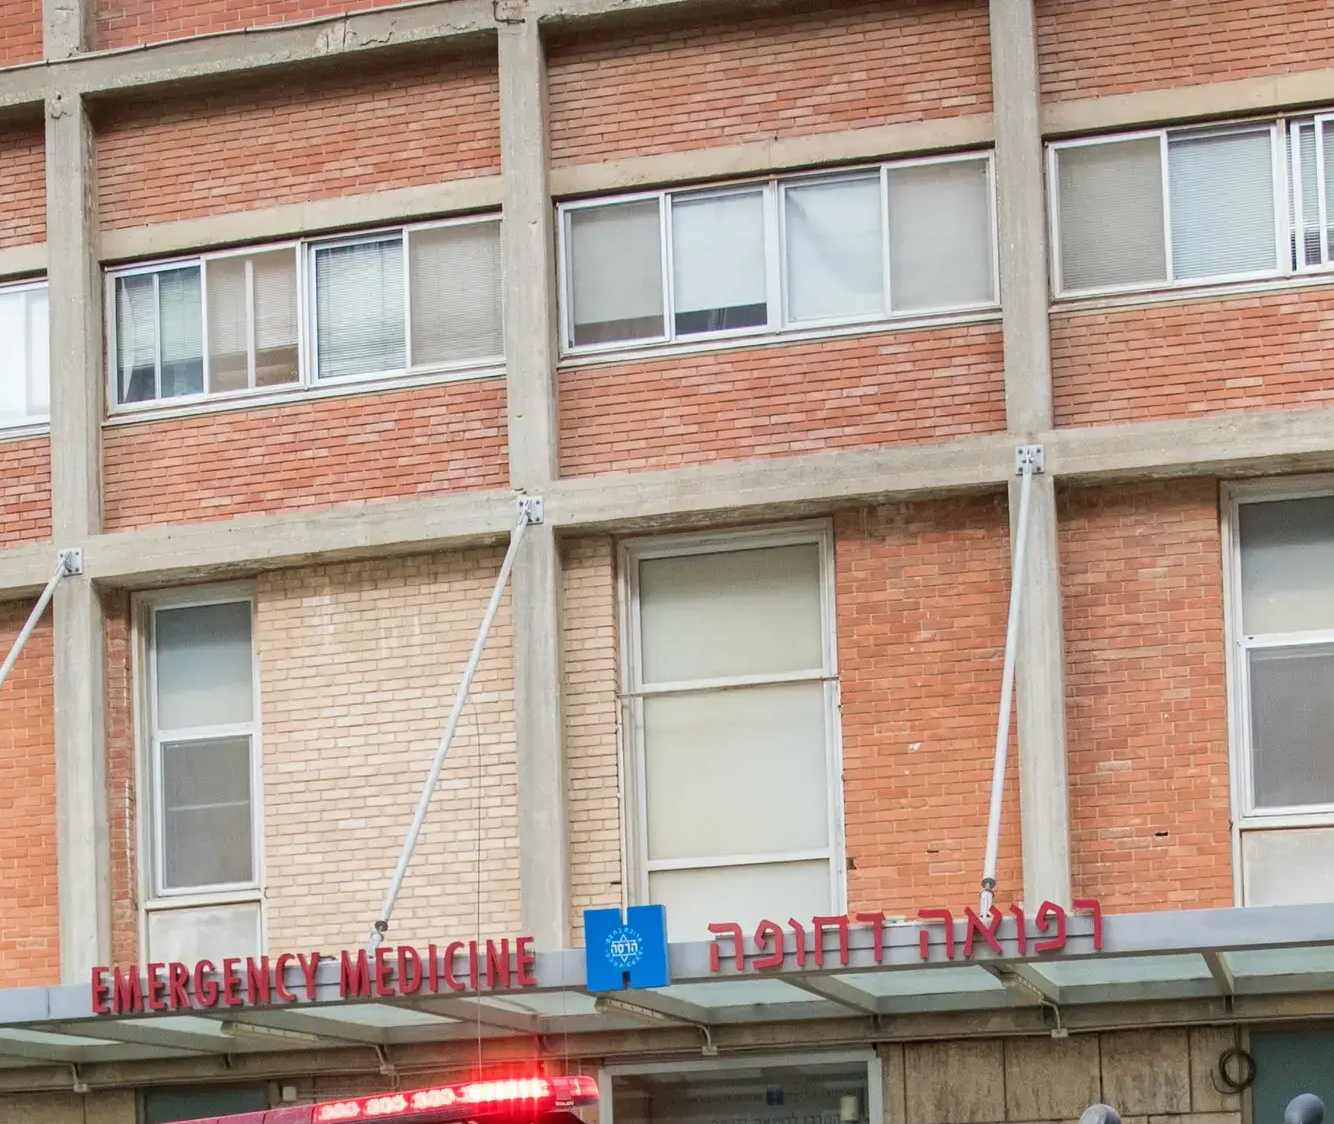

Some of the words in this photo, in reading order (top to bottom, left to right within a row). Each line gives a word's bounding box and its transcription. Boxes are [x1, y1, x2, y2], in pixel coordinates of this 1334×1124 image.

[707, 911, 886, 972] דחופה
[918, 899, 1104, 960] רפואה
[91, 952, 321, 1015] EMERGENCY
[339, 936, 538, 998] MEDICINE
